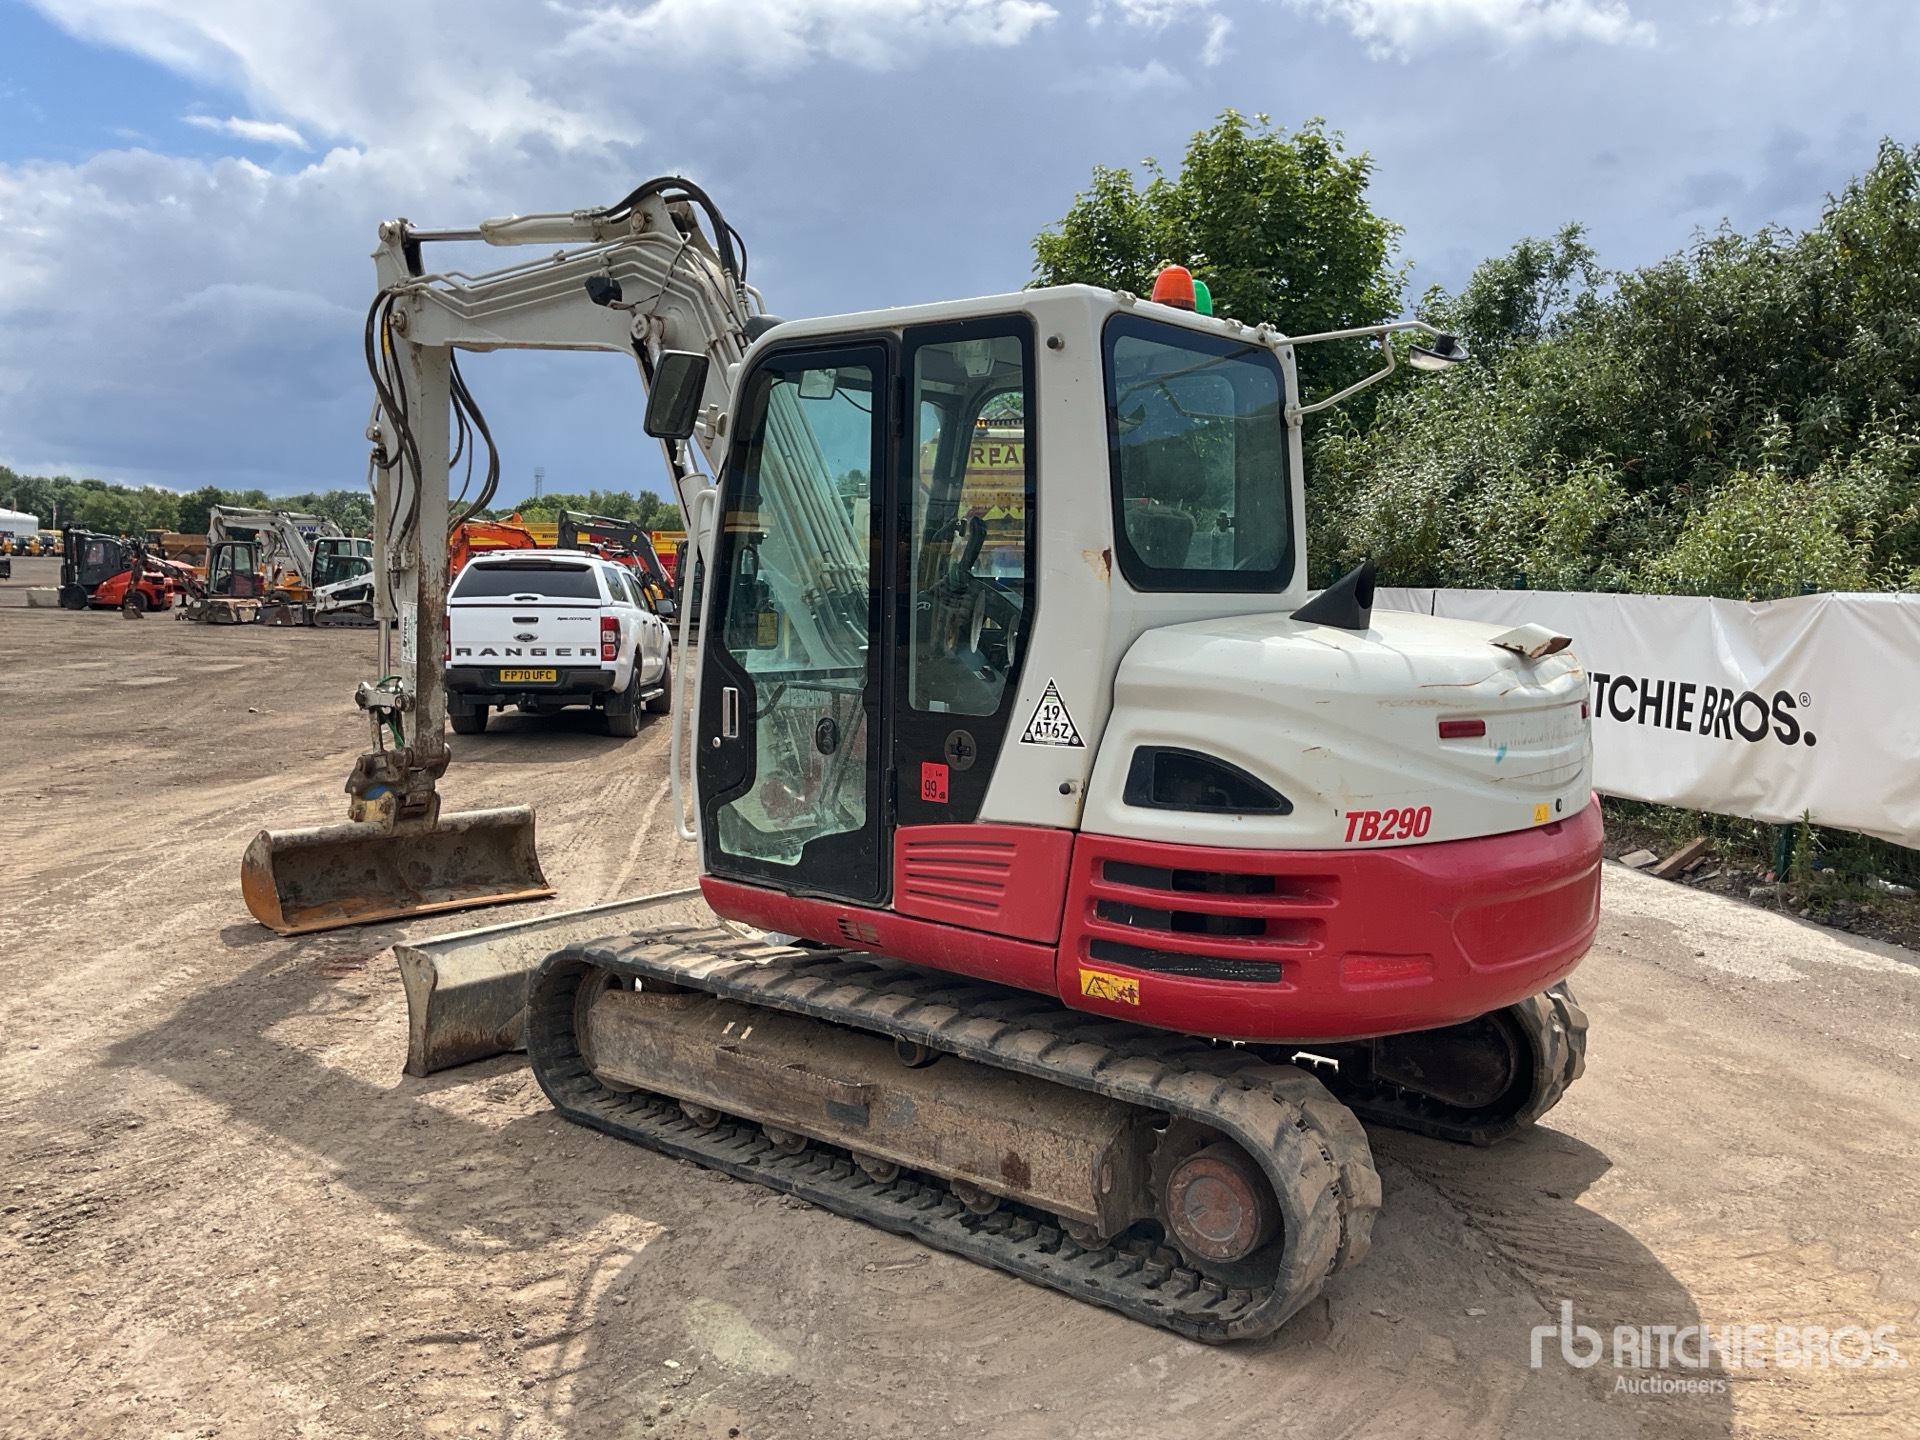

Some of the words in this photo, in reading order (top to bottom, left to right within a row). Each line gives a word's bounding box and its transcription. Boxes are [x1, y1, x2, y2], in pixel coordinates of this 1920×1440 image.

[971, 446, 1025, 466] REA
[455, 648, 597, 656] RANGER
[504, 671, 531, 680] FP70
[533, 671, 552, 680] UFC
[1043, 705, 1060, 720] 19
[1035, 721, 1069, 739] AT6Z
[924, 779, 937, 798] 99
[1345, 806, 1432, 842] TB290
